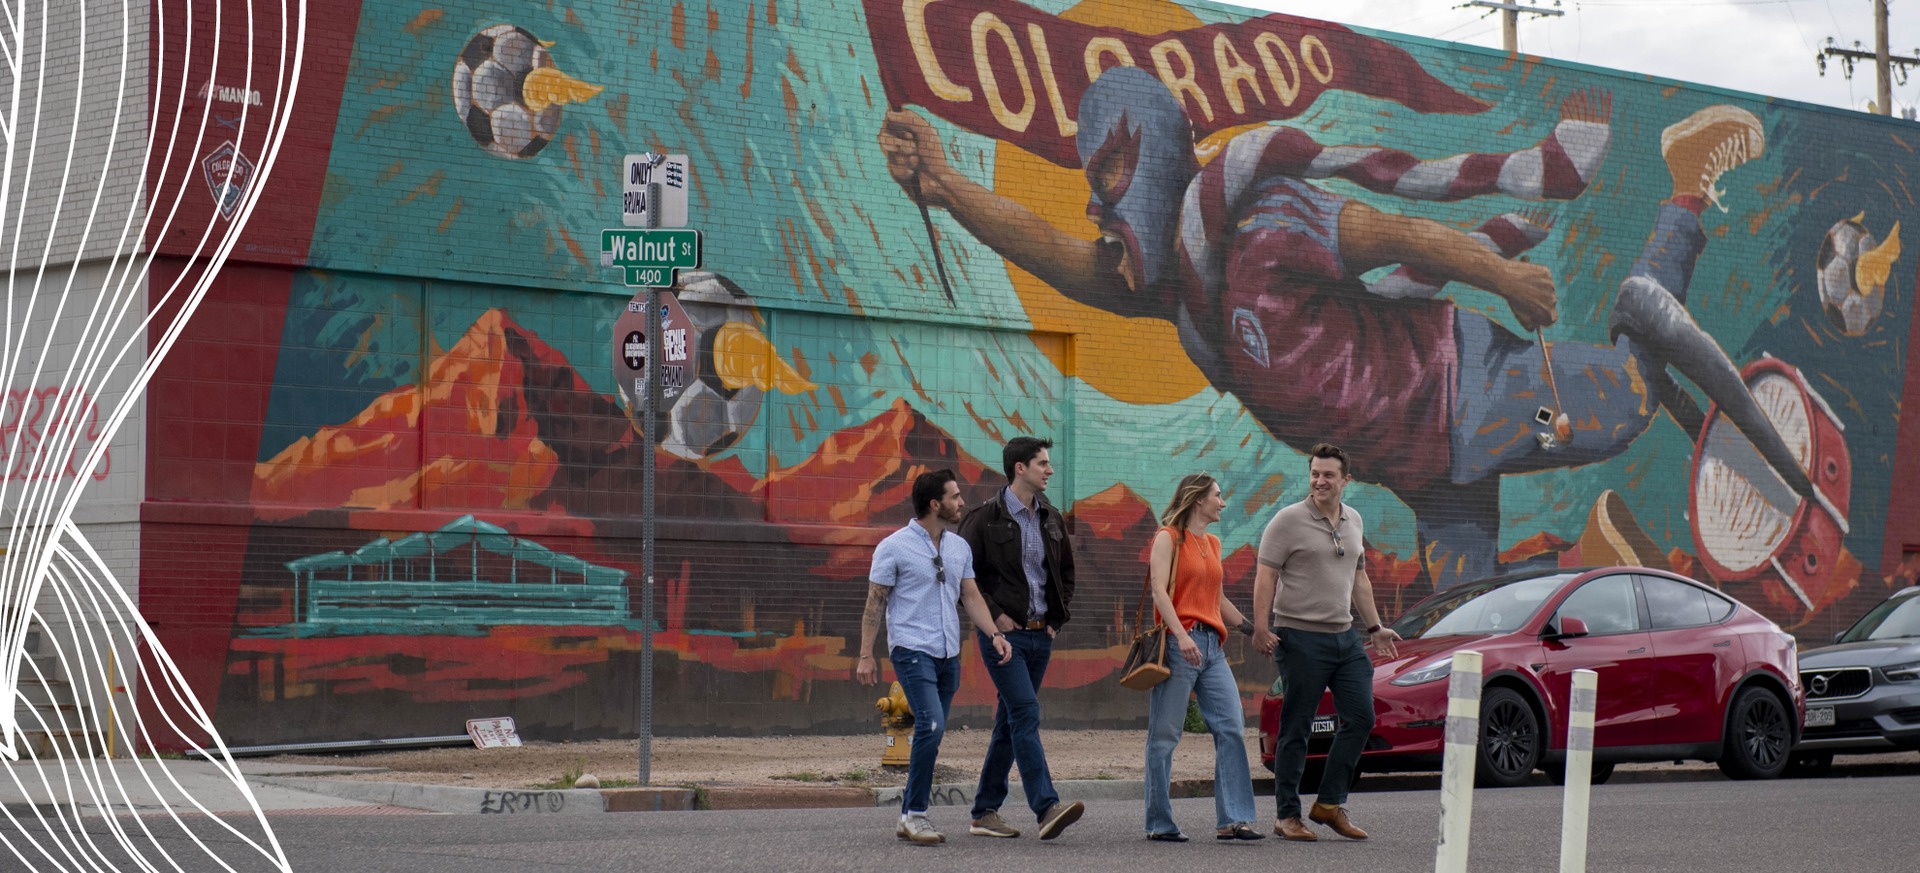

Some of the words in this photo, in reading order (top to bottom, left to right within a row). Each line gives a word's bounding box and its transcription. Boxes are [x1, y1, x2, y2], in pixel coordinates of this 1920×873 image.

[212, 160, 243, 176] COLORDO
[624, 191, 646, 213] BRUHA
[611, 235, 676, 262] Walnut
[681, 242, 692, 256] St
[635, 270, 662, 283] 1400
[664, 328, 686, 347] GENIE
[664, 345, 687, 362] TEASE
[486, 729, 497, 740] ANY
[491, 721, 511, 746] PARKING
[504, 728, 516, 739] NO
